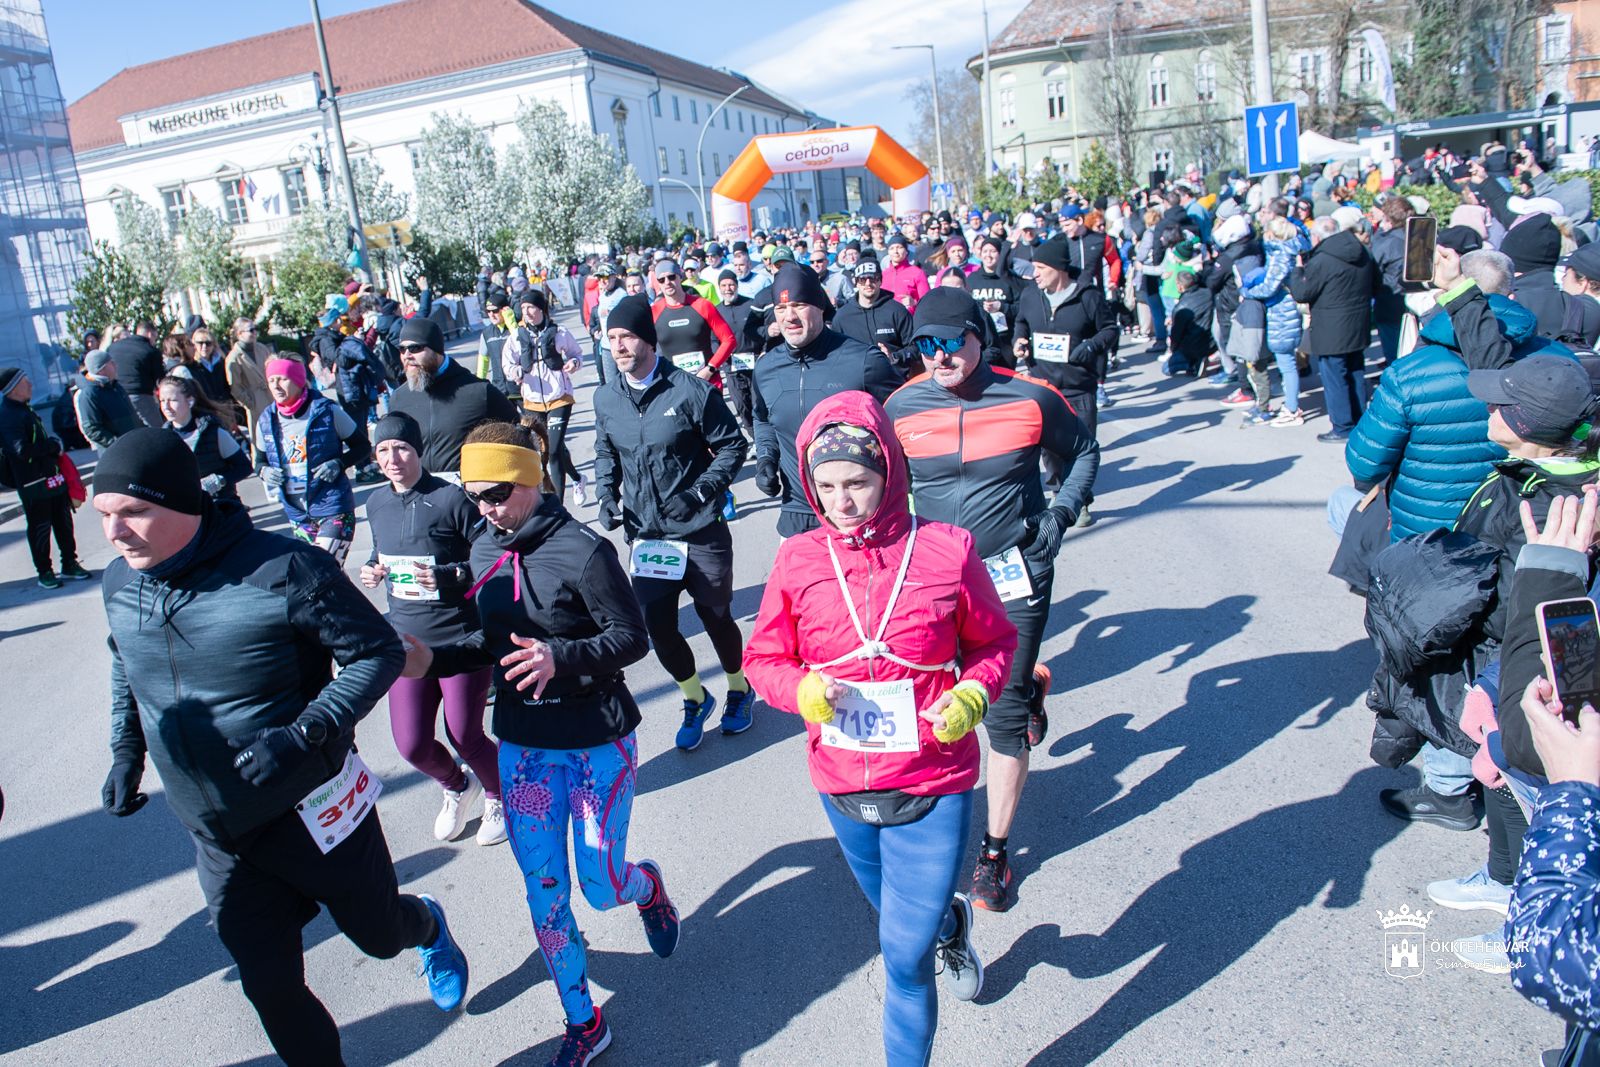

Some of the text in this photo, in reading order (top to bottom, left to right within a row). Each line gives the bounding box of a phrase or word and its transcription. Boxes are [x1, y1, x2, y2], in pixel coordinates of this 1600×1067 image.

[148, 93, 288, 134] MERCURE HOTEL
[785, 142, 849, 161] cerbona
[679, 359, 701, 369] 234
[638, 553, 681, 567] 142
[388, 572, 417, 584] 22
[835, 707, 897, 737] 7195
[317, 769, 369, 828] 376
